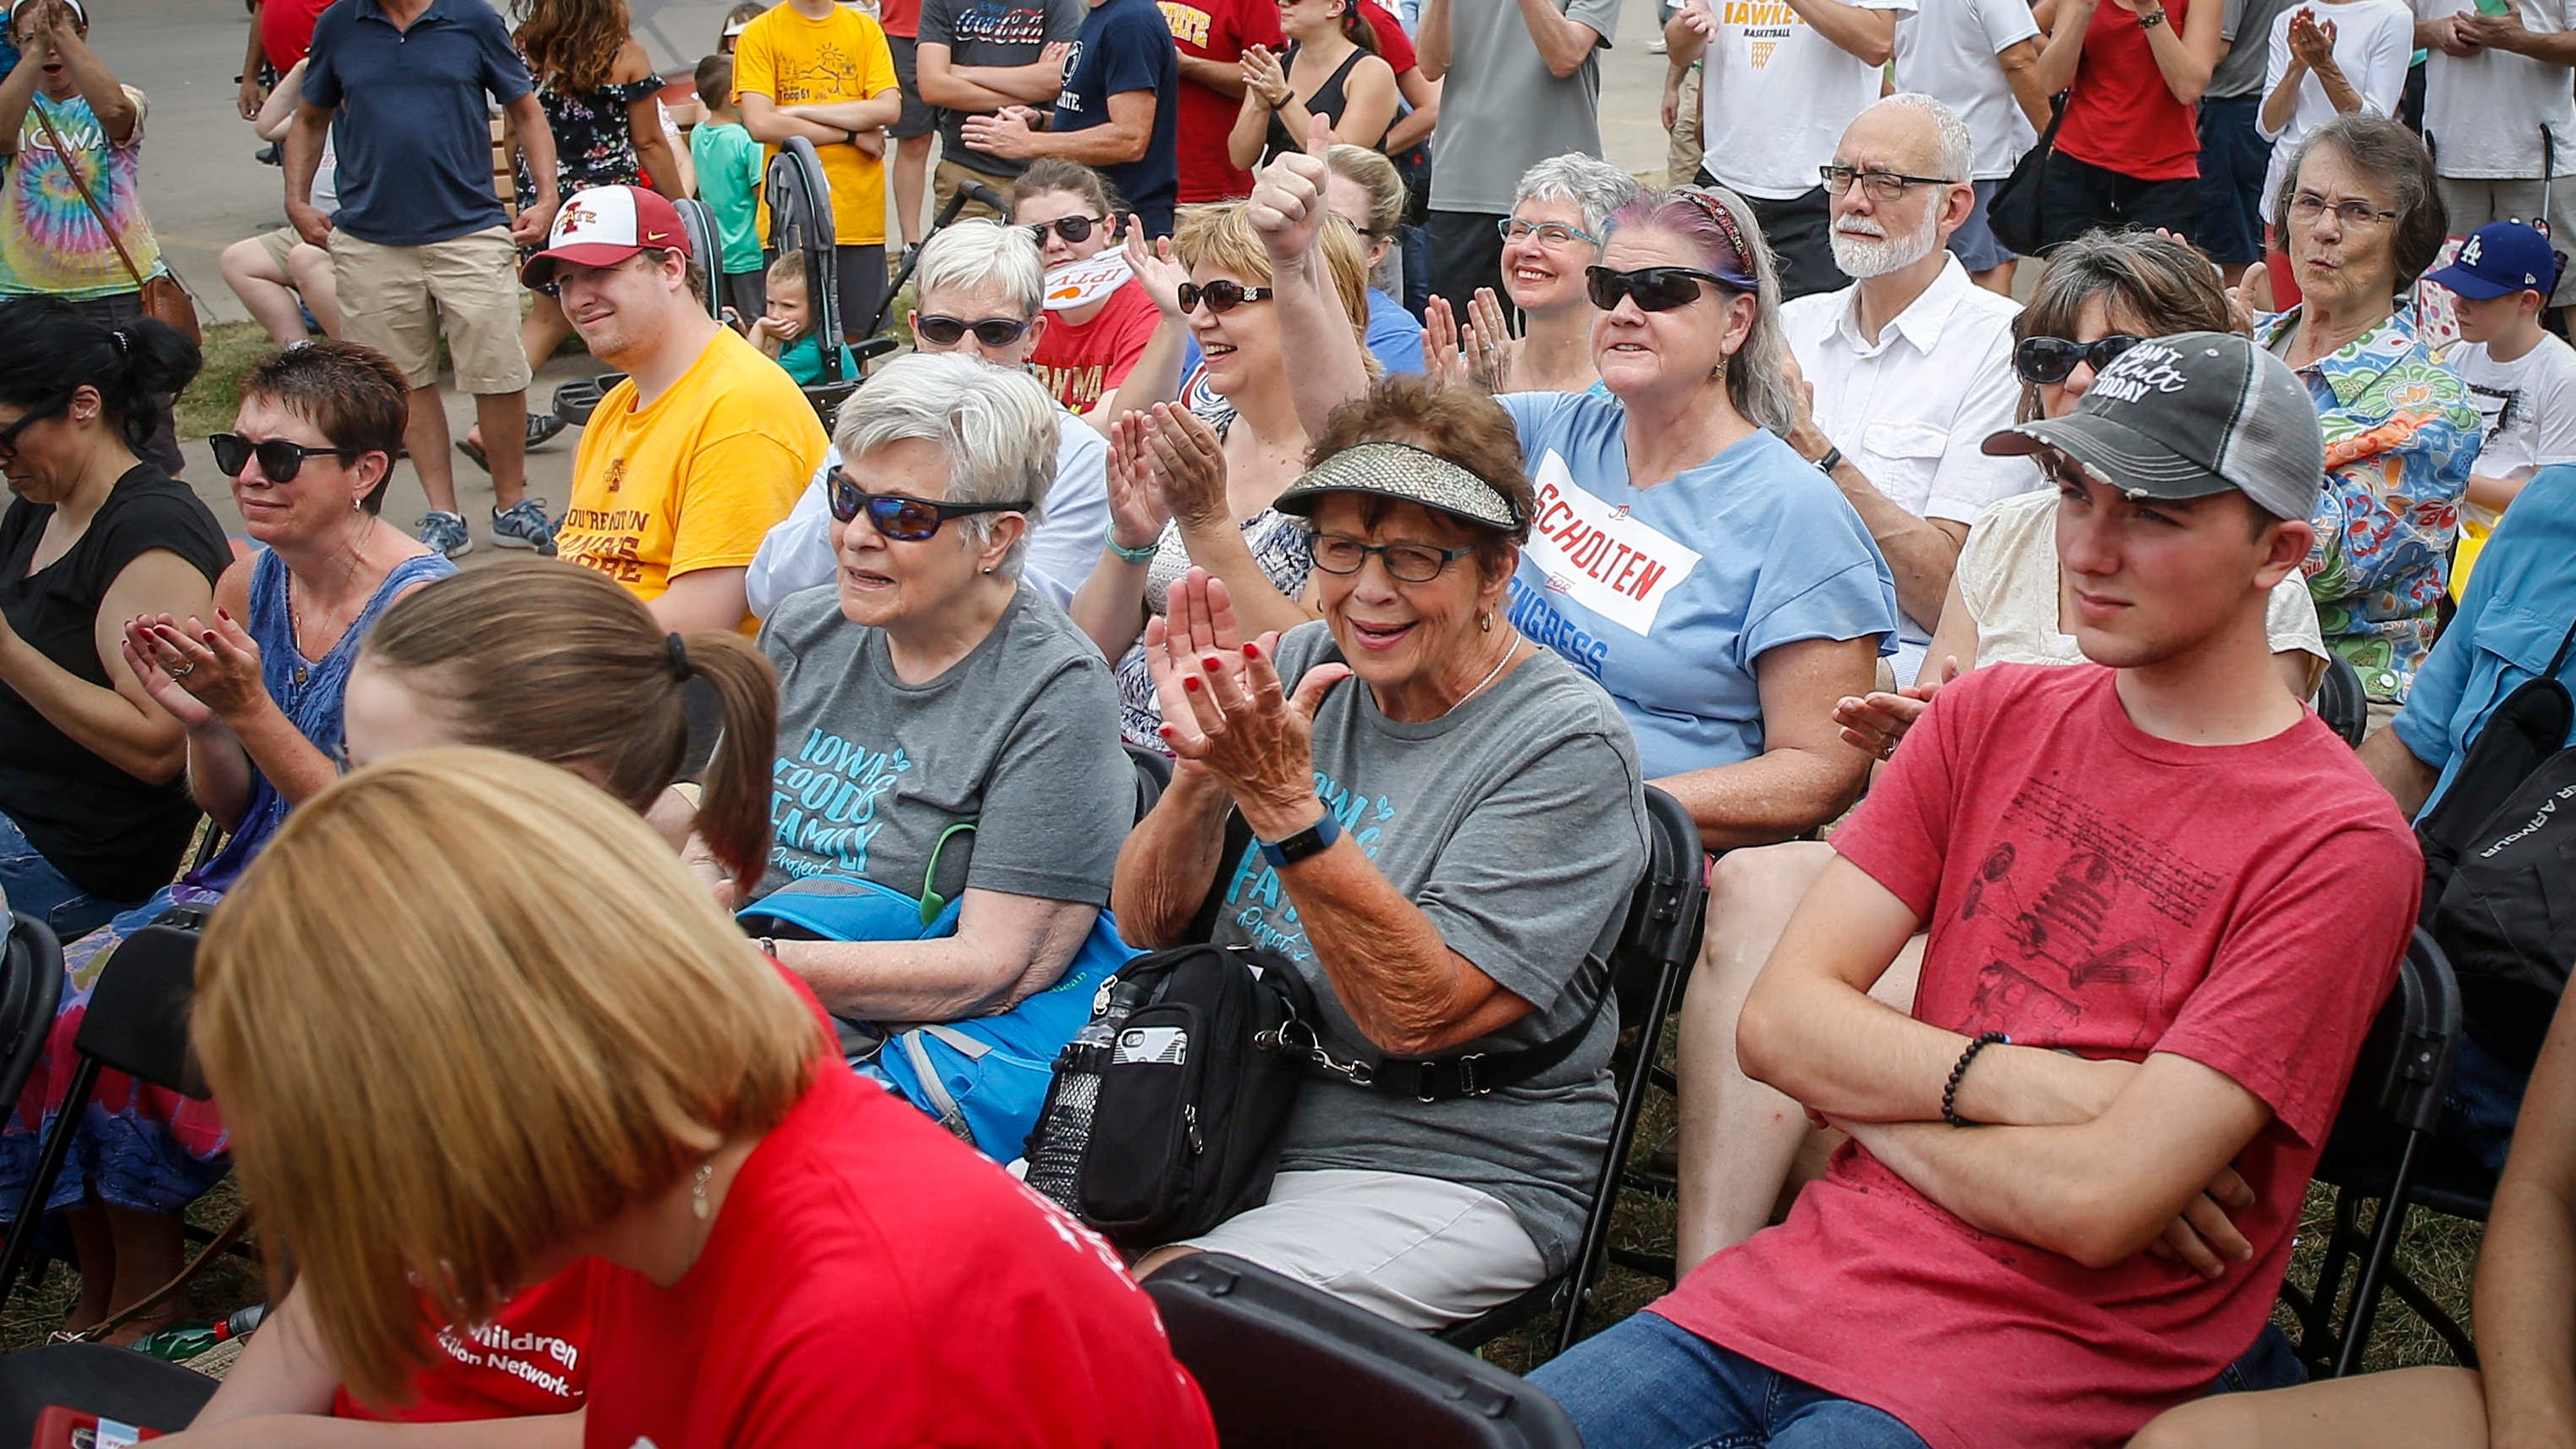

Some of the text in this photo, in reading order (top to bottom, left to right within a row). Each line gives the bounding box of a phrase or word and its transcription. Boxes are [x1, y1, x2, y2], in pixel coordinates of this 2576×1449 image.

[1743, 28, 1790, 38] BASKETBALL
[2460, 234, 2482, 267] LA
[2091, 376, 2151, 404] TODAY
[568, 508, 610, 531] OU'RE
[1531, 483, 1667, 602] SCHOLTEN
[1545, 576, 1572, 593] FOR
[799, 727, 889, 785] IOWA
[771, 791, 883, 872] FAMILY
[2479, 799, 2557, 858] ARMOUR
[436, 1324, 570, 1397] ction Network
[469, 1319, 578, 1371] hildren
